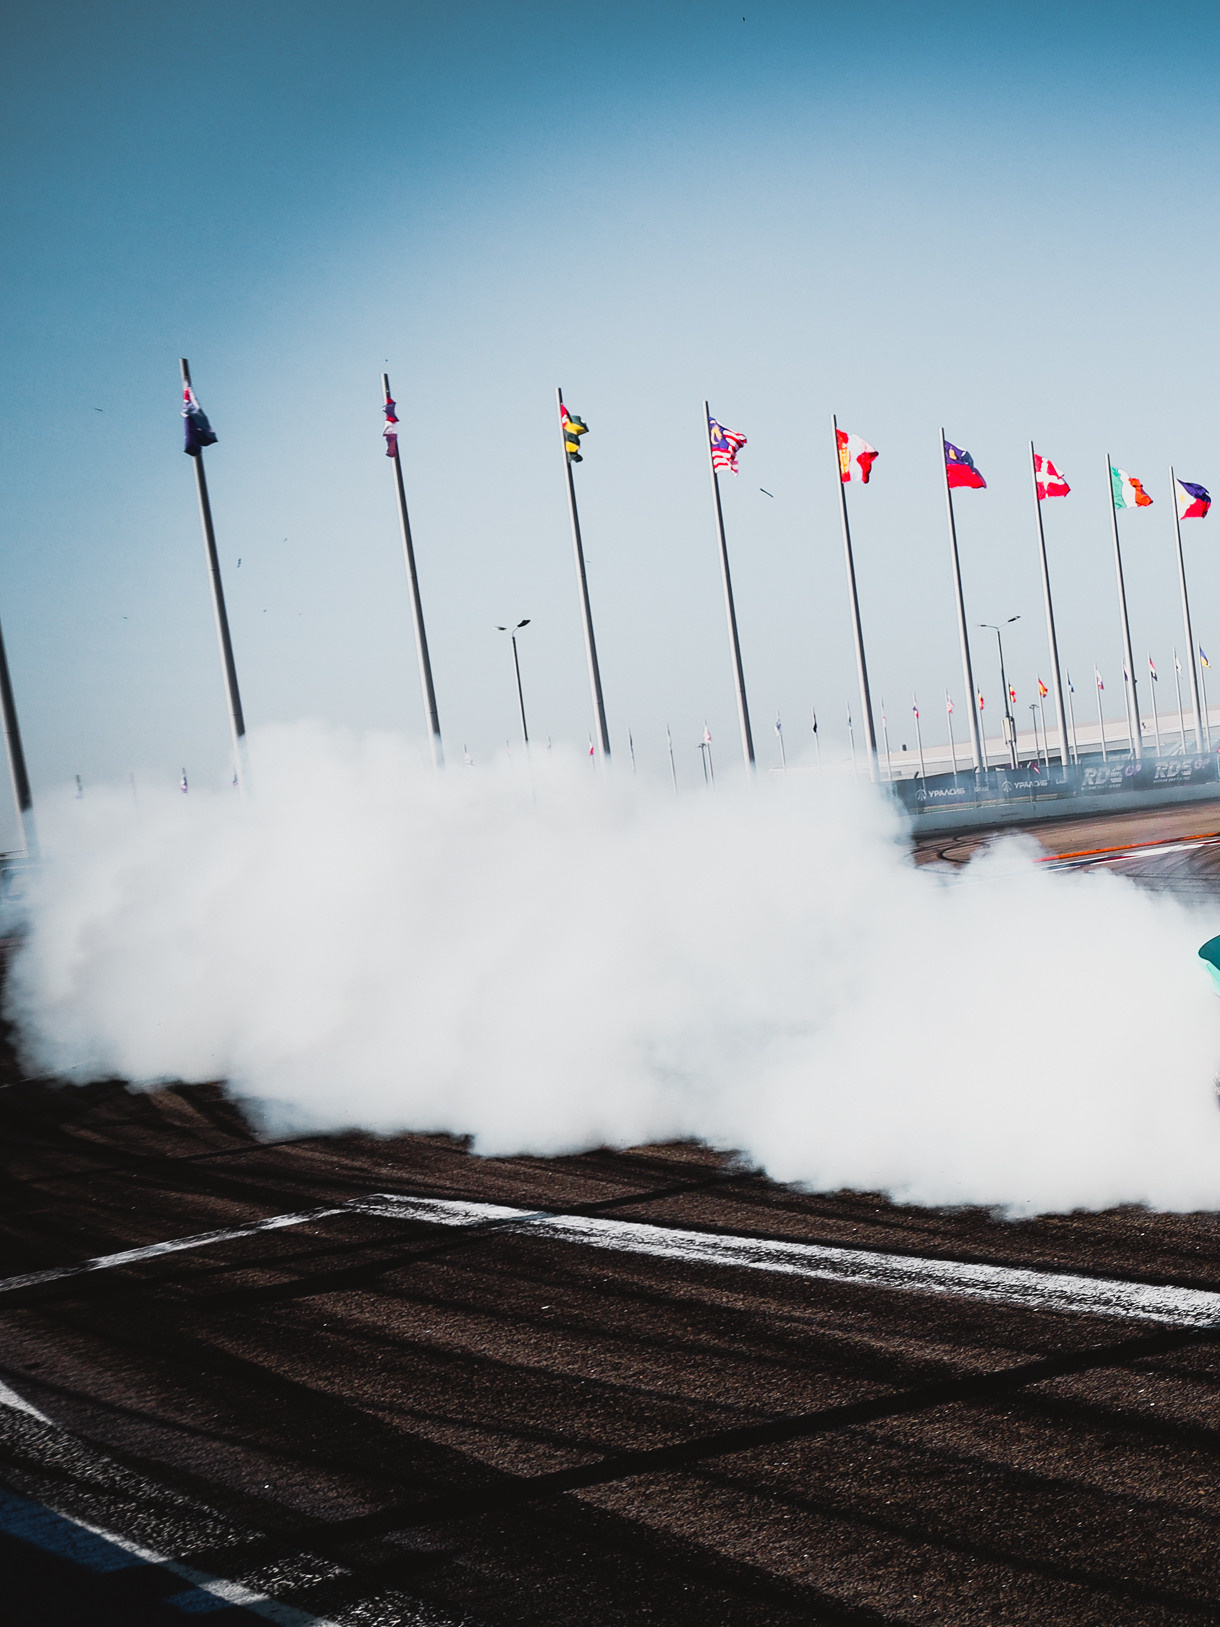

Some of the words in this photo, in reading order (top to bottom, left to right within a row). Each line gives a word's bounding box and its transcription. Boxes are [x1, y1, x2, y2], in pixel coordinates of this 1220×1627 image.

[1082, 764, 1125, 786] RDS
[1154, 759, 1194, 779] RDS
[928, 787, 966, 798] УРАЛСИБ
